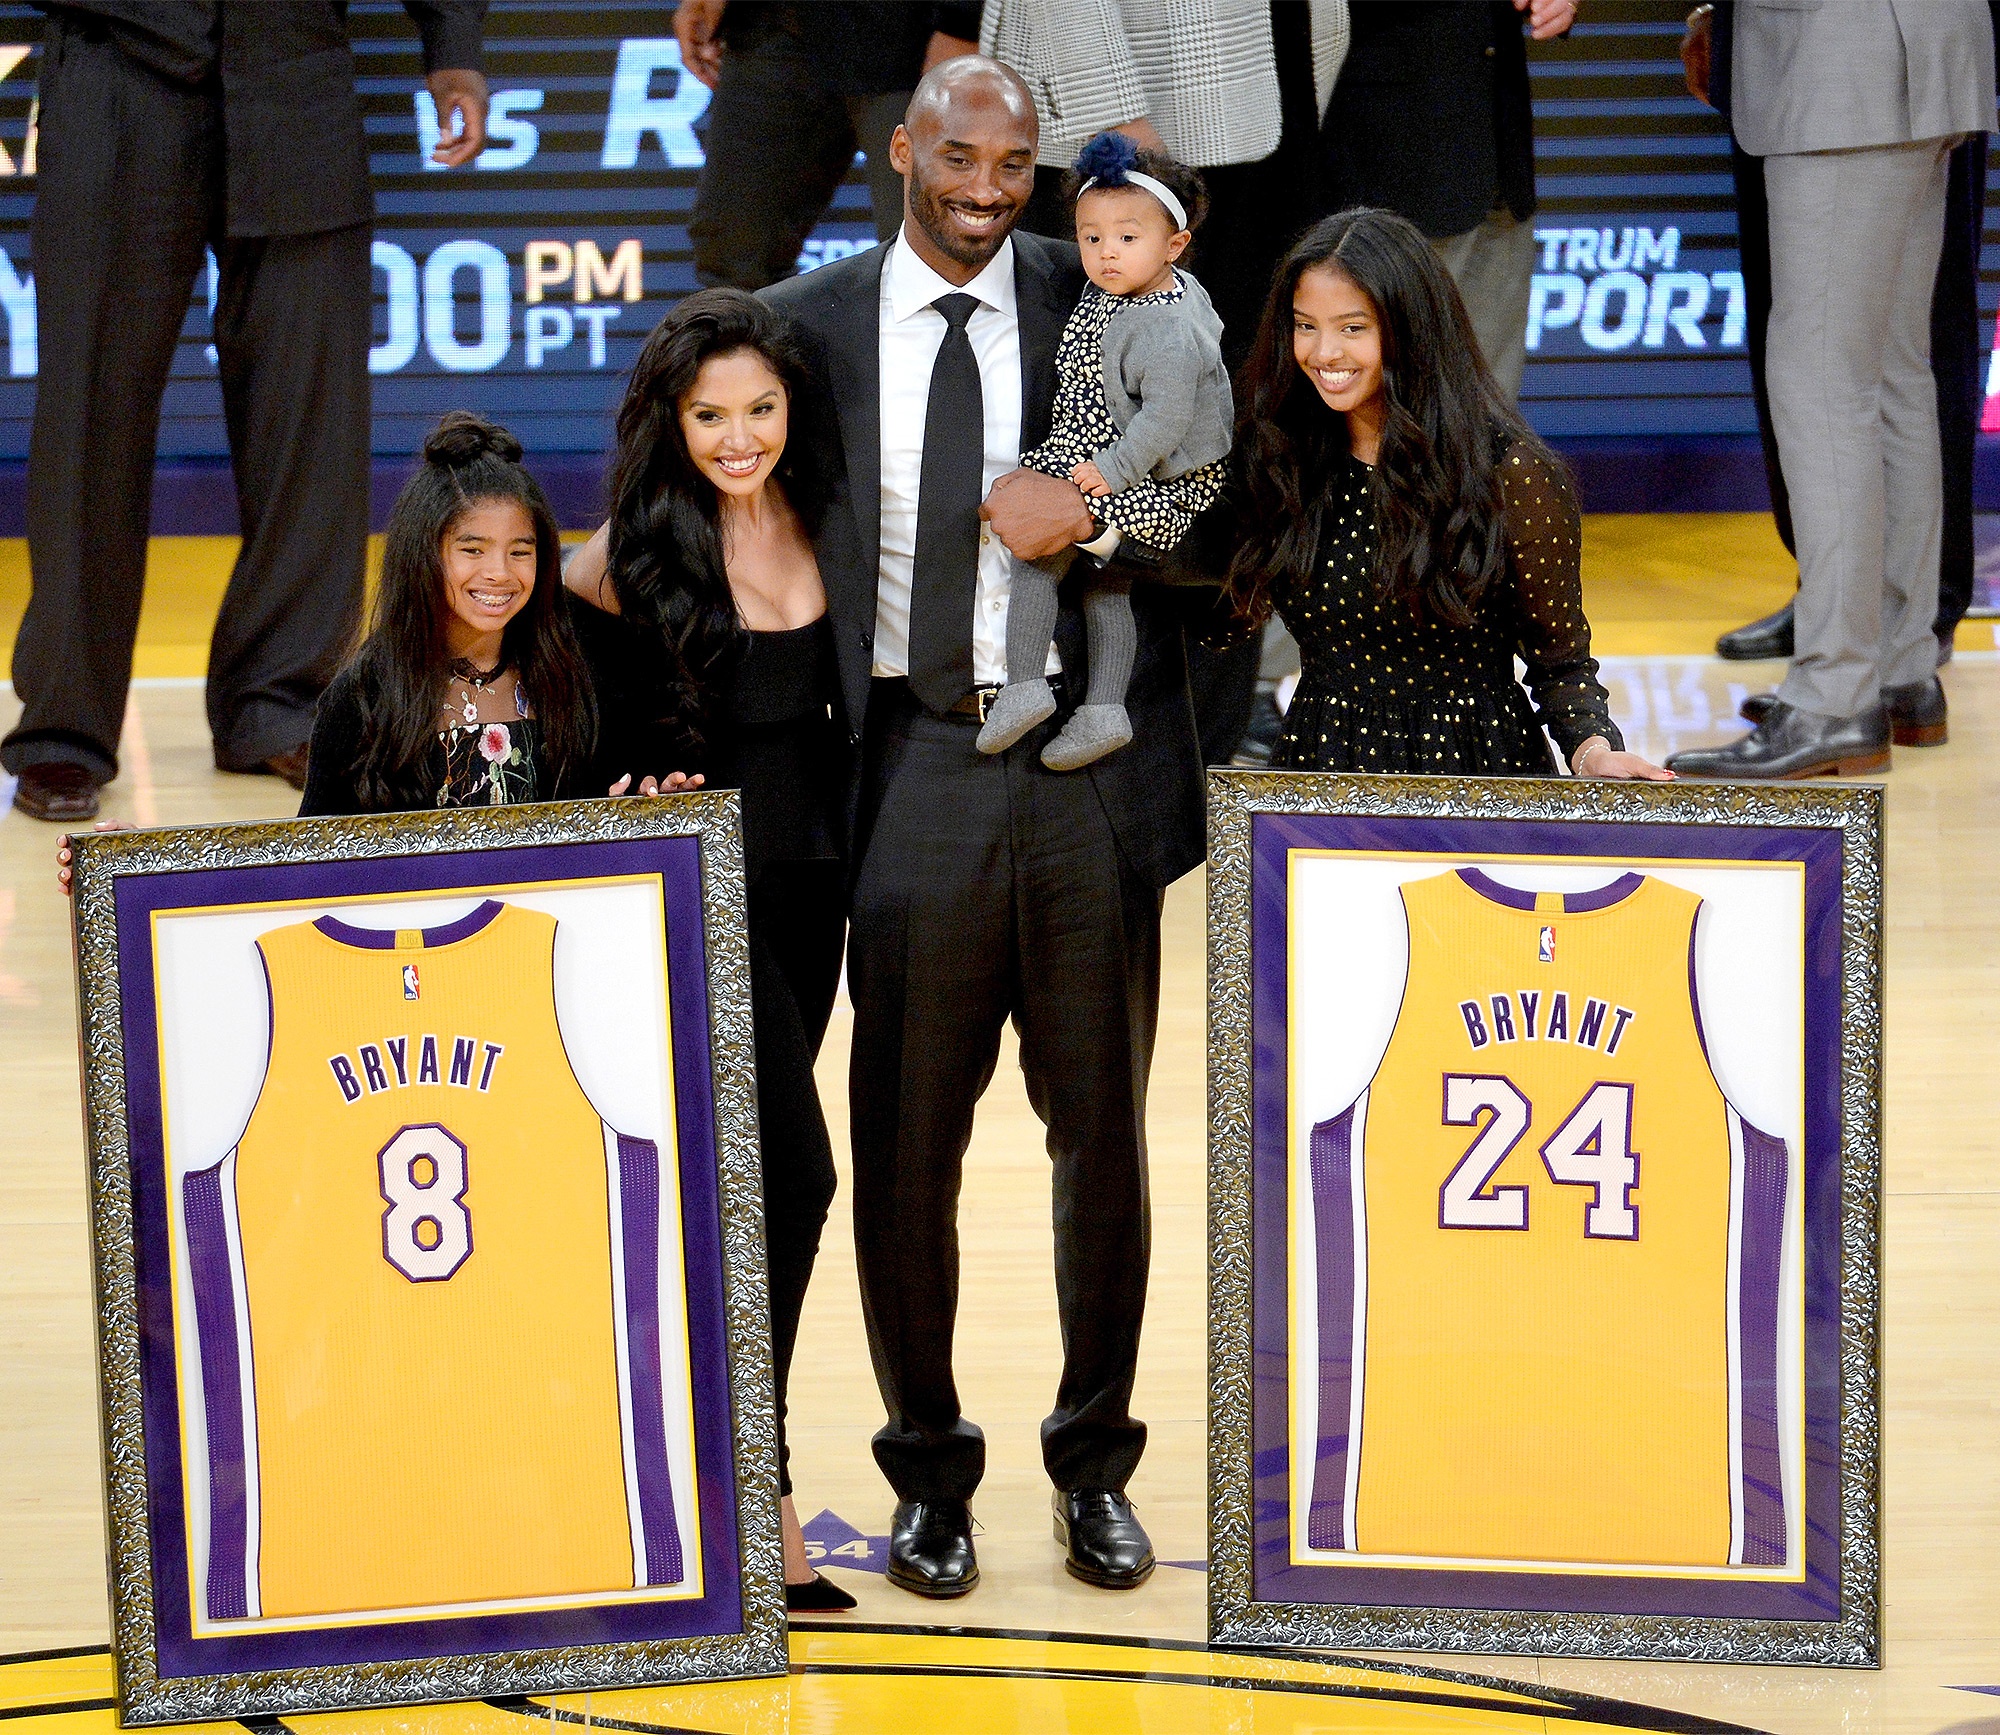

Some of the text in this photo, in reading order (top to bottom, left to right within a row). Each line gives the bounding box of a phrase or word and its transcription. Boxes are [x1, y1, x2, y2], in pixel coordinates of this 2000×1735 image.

[525, 239, 643, 302] PM
[525, 306, 621, 367] PT
[1458, 990, 1636, 1057] BRYANT
[327, 1033, 505, 1106] BRYANT
[1438, 1071, 1641, 1241] 24
[376, 1122, 474, 1284] 8
